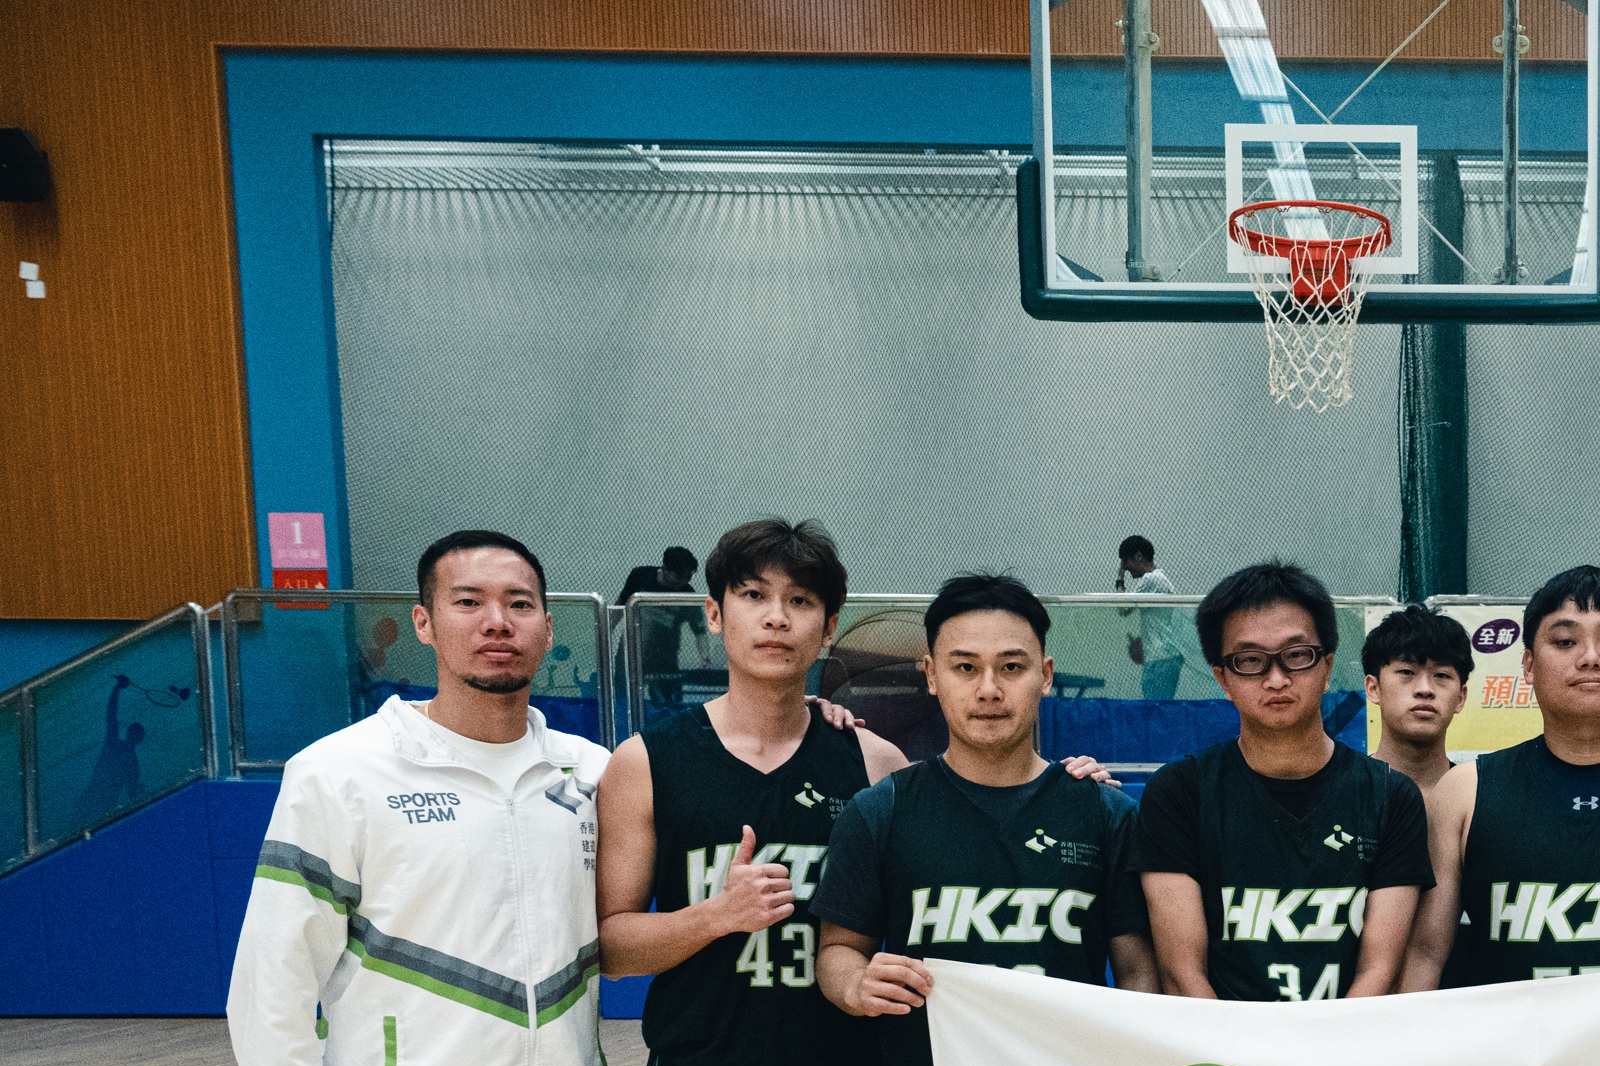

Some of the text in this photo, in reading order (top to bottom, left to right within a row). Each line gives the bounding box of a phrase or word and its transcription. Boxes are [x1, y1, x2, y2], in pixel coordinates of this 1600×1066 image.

[290, 521, 304, 545] 1
[1477, 627, 1516, 646] 全新
[386, 792, 461, 810] SPORTS
[402, 807, 456, 824] TEAM
[906, 885, 1097, 947] HKIC
[735, 922, 817, 988] 43
